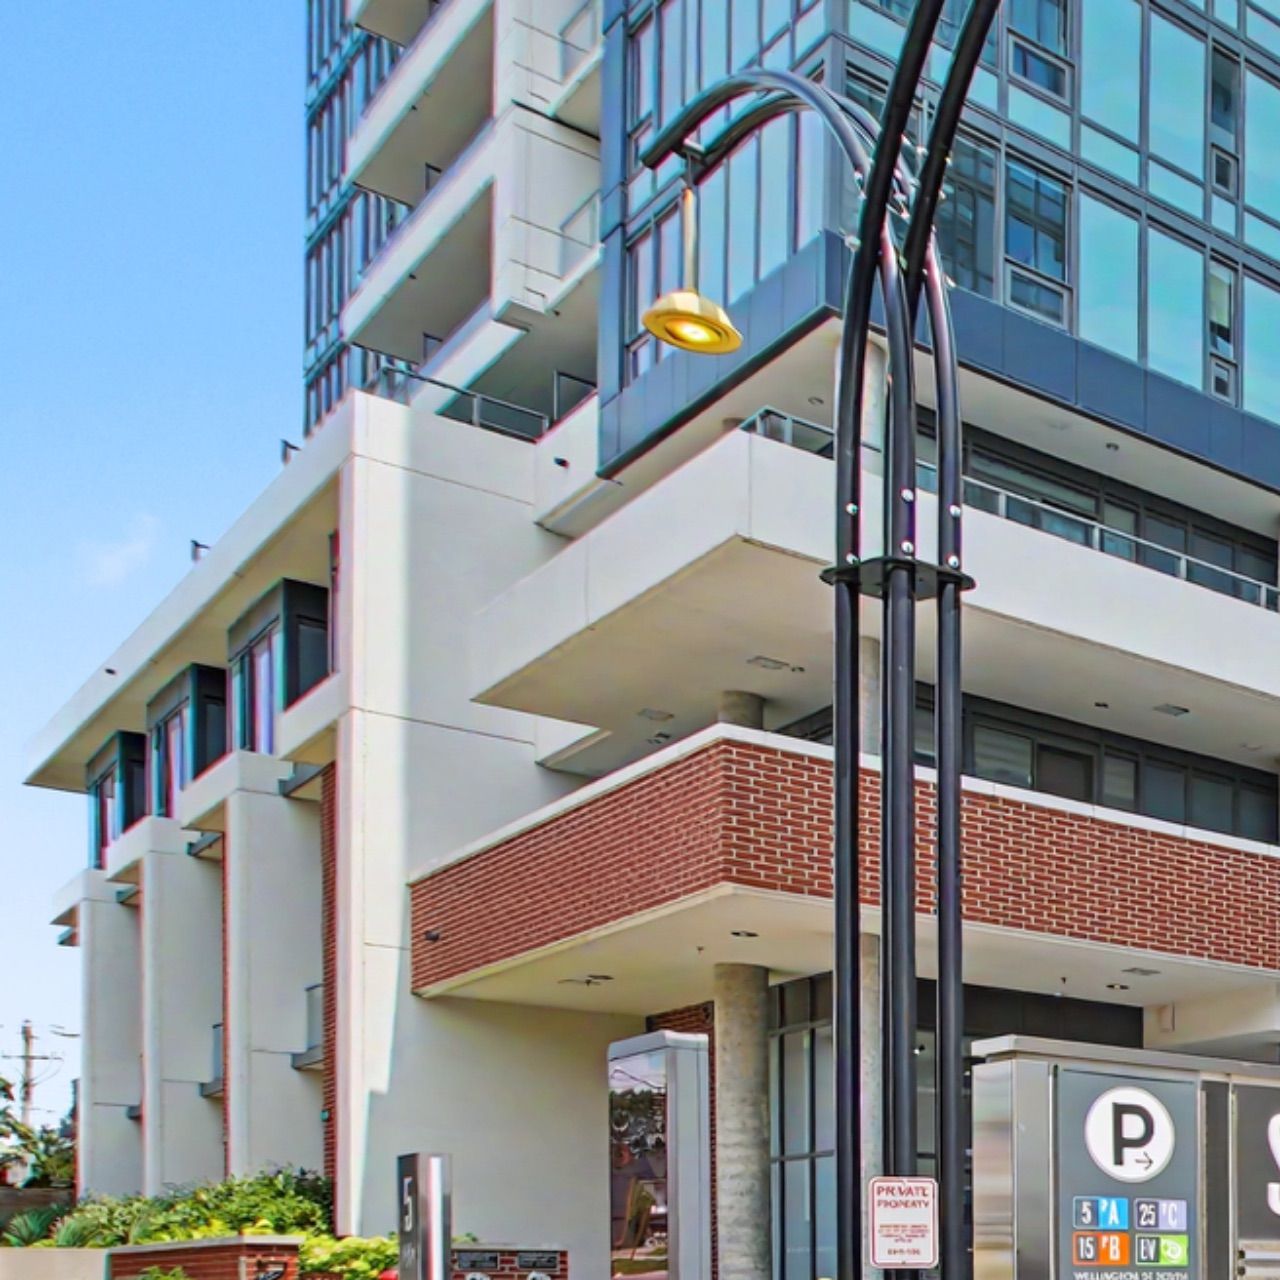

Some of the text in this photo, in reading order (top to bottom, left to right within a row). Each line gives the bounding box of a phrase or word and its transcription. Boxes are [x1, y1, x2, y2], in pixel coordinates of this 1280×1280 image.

[1112, 1102, 1155, 1166] P
[403, 1176, 413, 1232] 5
[1081, 1201, 1092, 1224] 5
[1139, 1203, 1156, 1226] 25
[1078, 1236, 1095, 1260] 15
[1141, 1238, 1156, 1261] EV
